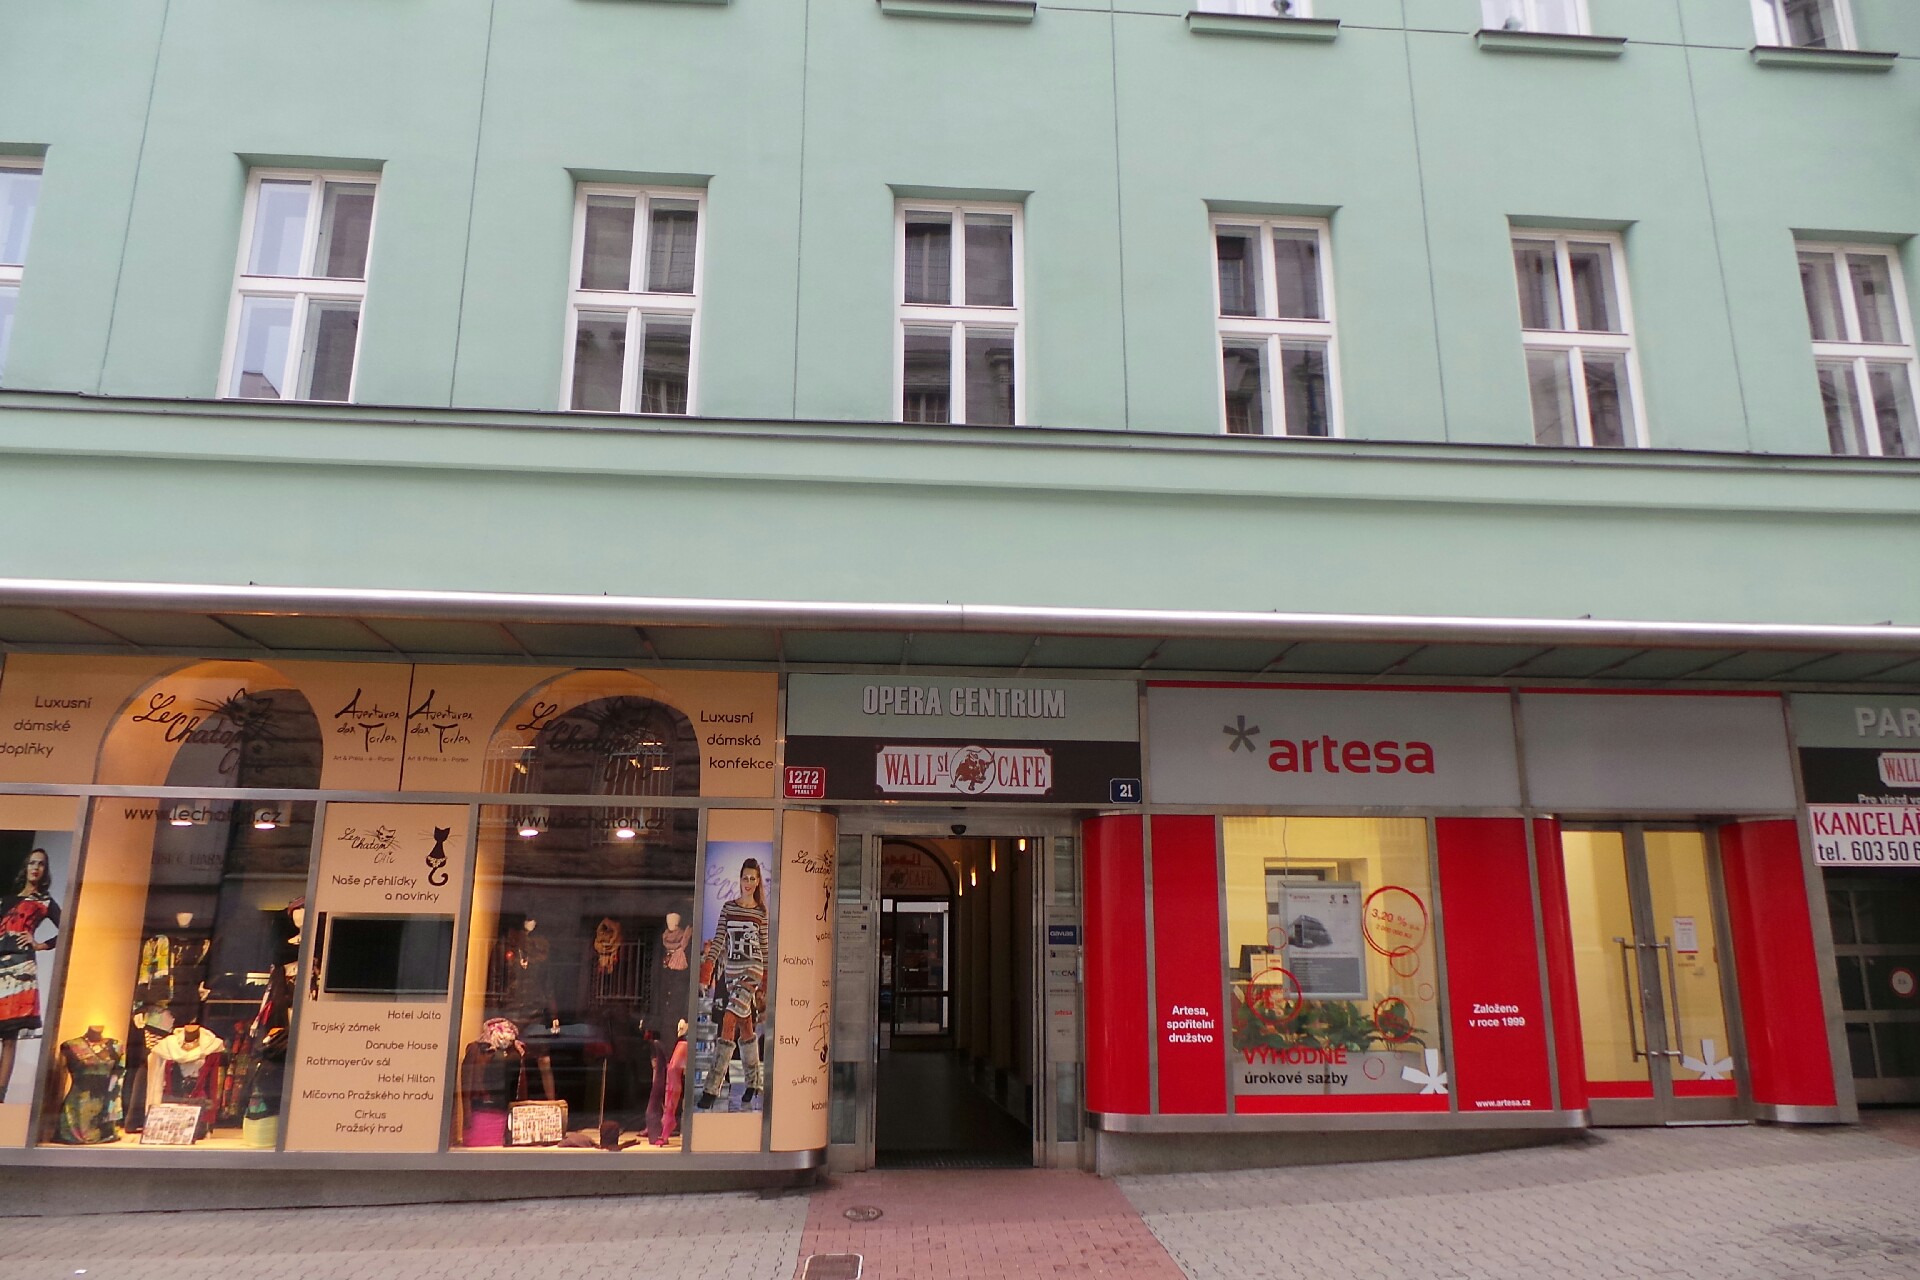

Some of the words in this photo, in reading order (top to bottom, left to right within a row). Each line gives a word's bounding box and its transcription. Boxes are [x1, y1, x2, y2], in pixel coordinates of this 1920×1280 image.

[35, 695, 93, 709] Luxusní
[862, 685, 942, 716] OPERA
[948, 687, 1066, 719] CENTRUM
[700, 710, 754, 723] Luxusní
[13, 718, 71, 731] dámské
[706, 733, 761, 746] dámská
[1268, 735, 1435, 774] artesa
[709, 756, 774, 770] konfekce
[883, 753, 937, 786] WALL
[997, 755, 1046, 787] CAFE
[788, 770, 819, 784] 1272
[1119, 783, 1133, 798] 21
[1818, 841, 1846, 861] tel.
[1852, 841, 1885, 861] 603
[1888, 841, 1909, 861] 50
[332, 875, 361, 886] Naše
[395, 891, 440, 903] novinky
[790, 997, 810, 1008] topy
[1472, 1003, 1519, 1014] Založeno
[387, 1010, 414, 1020] Hotel
[1171, 1005, 1209, 1018] Artesa,
[311, 1022, 345, 1034] Trojský
[348, 1022, 381, 1032] zámek
[1166, 1018, 1215, 1031] spořitelní
[1469, 1019, 1475, 1027] v
[1478, 1018, 1501, 1027] roce
[1502, 1016, 1526, 1028] 1999
[779, 1035, 800, 1047] šaty
[1168, 1032, 1214, 1044] družstvo
[365, 1040, 404, 1050] Danube
[407, 1041, 439, 1050] House
[1243, 1043, 1348, 1065] VÝHODNÉ
[306, 1056, 373, 1068] Rothmayerův
[376, 1056, 391, 1066] sál
[378, 1073, 404, 1083] Hotel
[407, 1073, 436, 1083] Hilton
[1244, 1070, 1303, 1084] úrokové
[1307, 1070, 1349, 1087] sazby
[302, 1089, 345, 1100] Míčovna
[348, 1089, 401, 1100] Pražského
[403, 1090, 434, 1101] hradu
[1475, 1098, 1532, 1108] www.artesa.cz
[355, 1109, 387, 1119] Cirkus
[335, 1122, 376, 1135] Pražský
[378, 1123, 403, 1133] hrad
